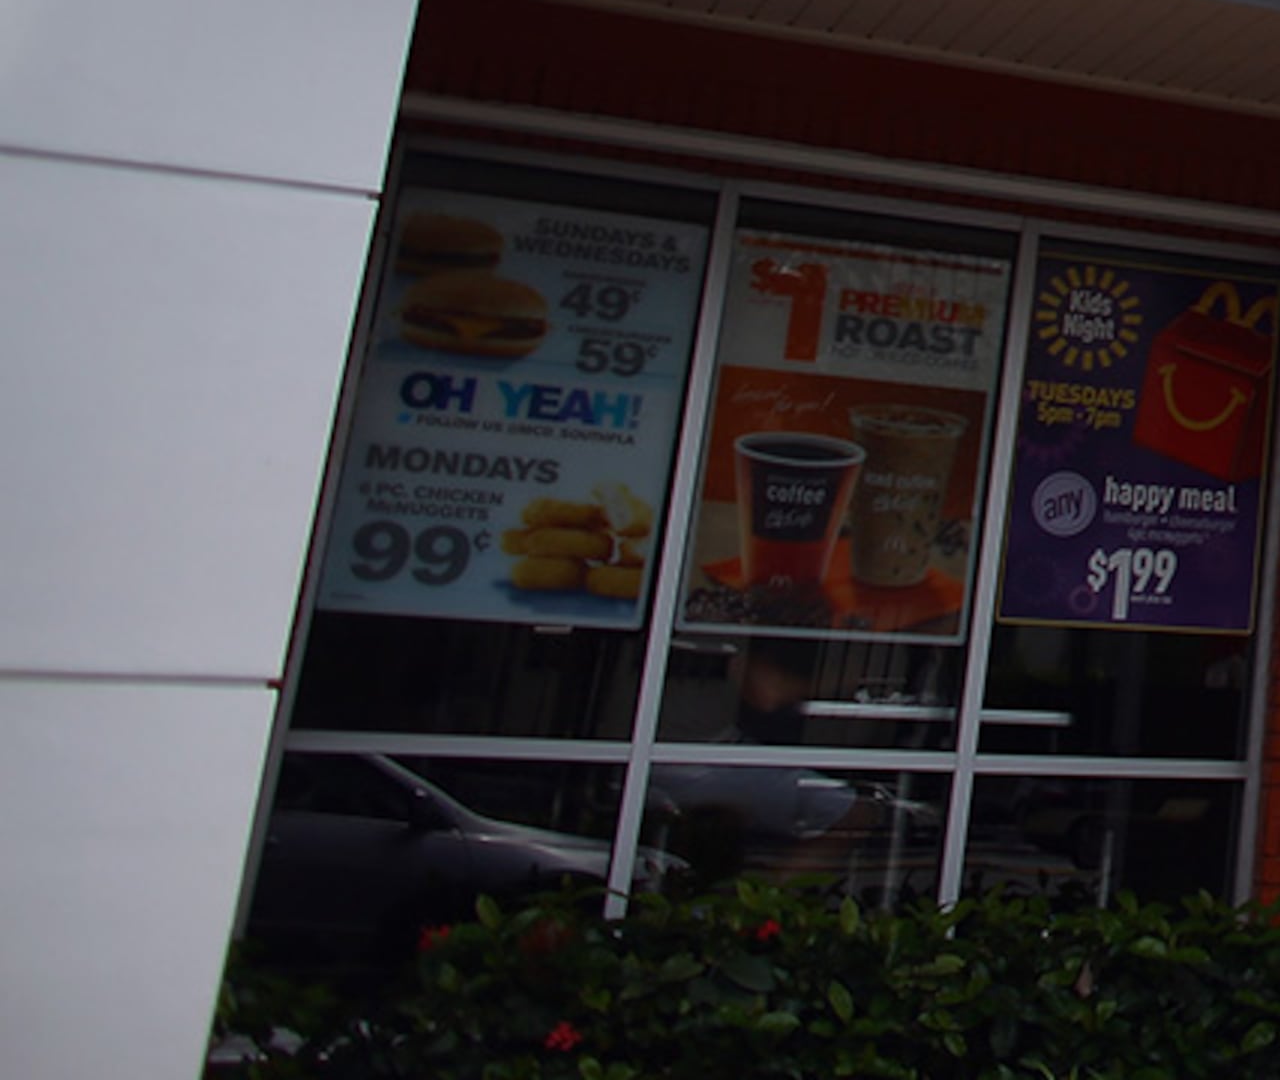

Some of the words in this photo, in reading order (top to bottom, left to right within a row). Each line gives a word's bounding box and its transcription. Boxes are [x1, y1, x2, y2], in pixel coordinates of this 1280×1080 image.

[534, 217, 655, 248] SUNDAYS
[661, 234, 678, 252] &
[513, 235, 691, 273] WEDNESDAYS
[839, 288, 986, 329] PREMIUM
[1069, 289, 1114, 318] Kids
[835, 314, 984, 357] ROAST
[1062, 313, 1116, 344] Night
[399, 371, 477, 412] OH
[496, 380, 644, 429] YEAH!
[1028, 379, 1137, 409] TUESDAYS
[365, 443, 560, 484] MONDAYS
[365, 498, 490, 521] McNUGGETS
[413, 485, 505, 506] CHICKEN
[765, 482, 827, 505] coffee
[1042, 488, 1085, 521] any
[1103, 474, 1176, 516] happy
[1177, 483, 1238, 514] meal
